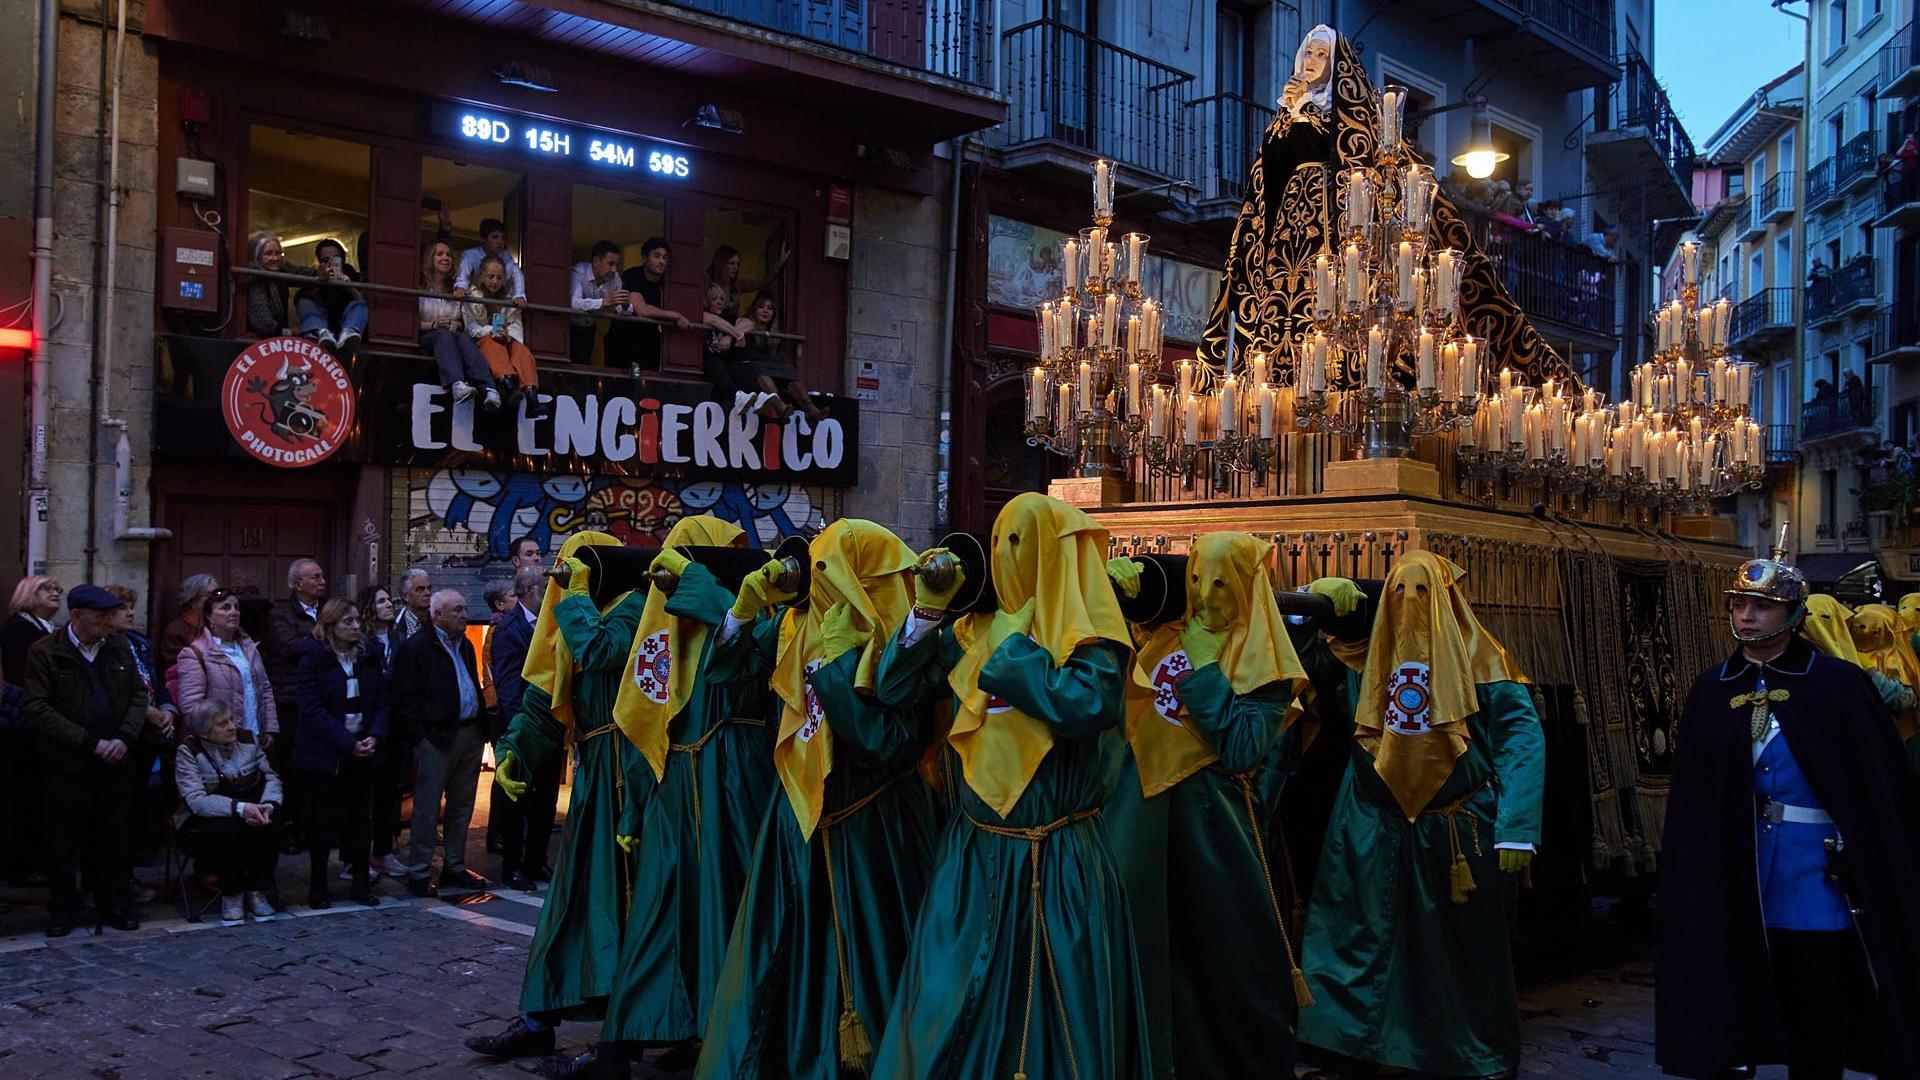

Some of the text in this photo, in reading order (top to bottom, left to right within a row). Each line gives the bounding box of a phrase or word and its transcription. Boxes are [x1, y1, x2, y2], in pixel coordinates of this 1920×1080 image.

[462, 115, 690, 177] 89D 15H 54M 59S
[236, 354, 257, 373] EL
[411, 383, 485, 452] EL
[241, 430, 333, 463] PHOTOCALL
